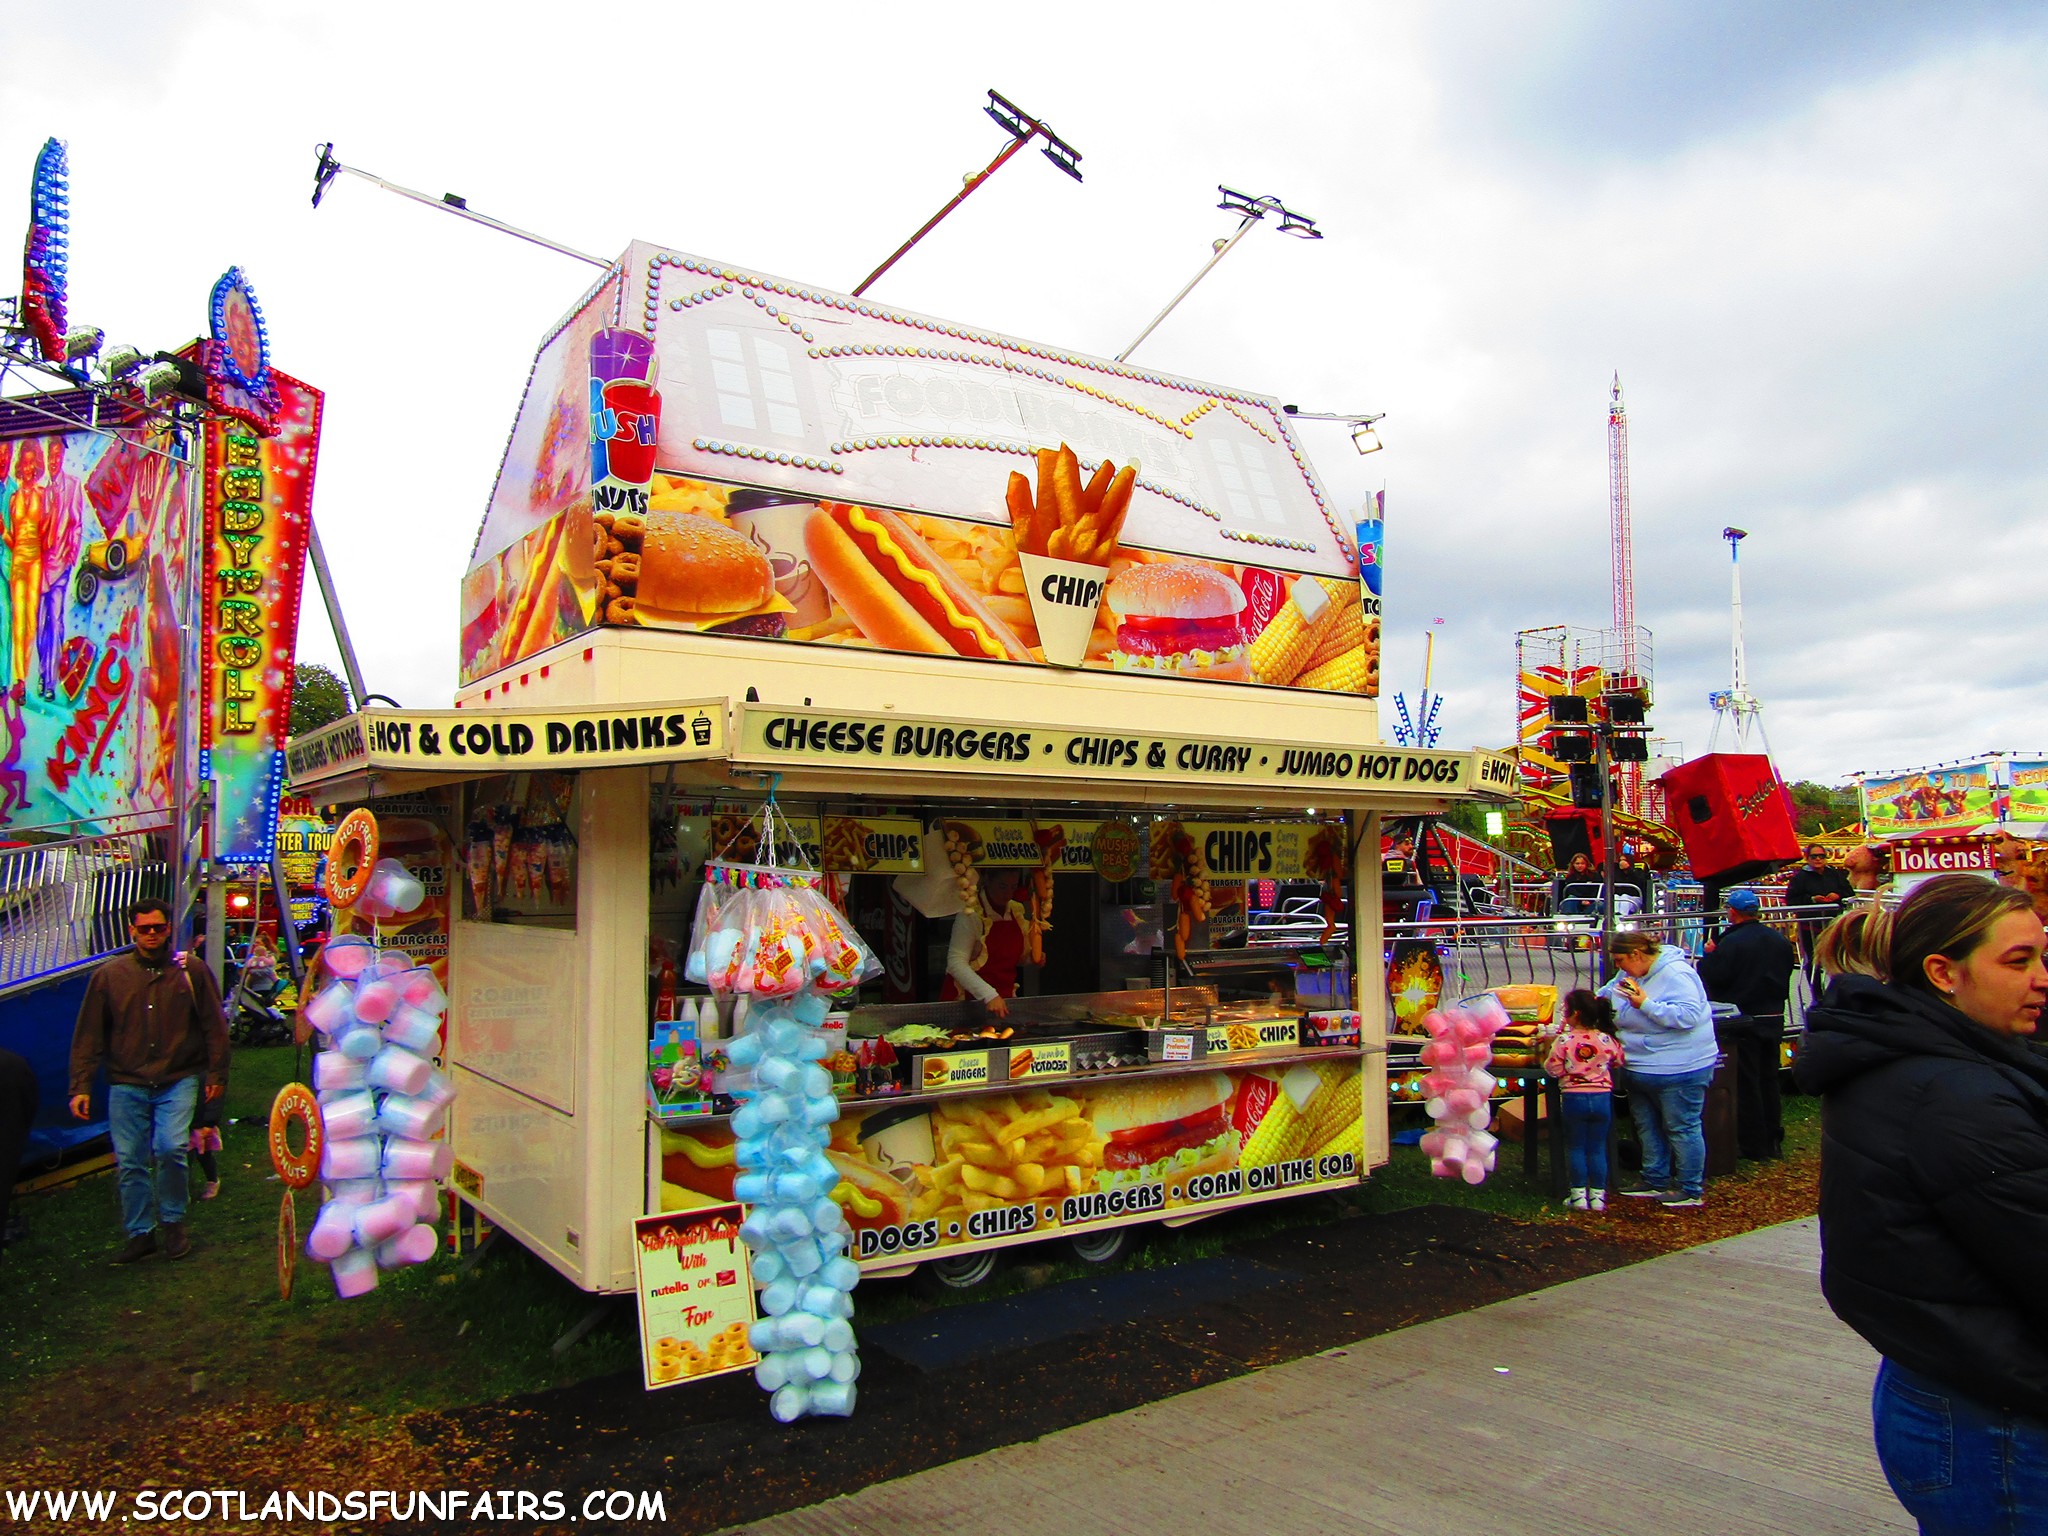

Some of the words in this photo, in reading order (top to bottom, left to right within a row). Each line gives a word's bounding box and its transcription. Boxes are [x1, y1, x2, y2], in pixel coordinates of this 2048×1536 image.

[590, 408, 656, 446] USH
[592, 485, 649, 516] NUTS
[219, 600, 263, 736] ROLL
[376, 720, 411, 754] HOT
[419, 723, 441, 755] &
[450, 723, 533, 755] COLD
[545, 713, 686, 755] DRINKS
[764, 717, 886, 755] CHEESE
[893, 725, 1031, 762] BURGERS
[1066, 736, 1139, 767] CHIPS
[1147, 742, 1166, 769] &
[1177, 744, 1252, 772] CURRY
[1276, 749, 1352, 779] JUMBO
[1357, 754, 1405, 779] HOT
[1404, 757, 1460, 783] DOGS
[1489, 758, 1511, 785] HOT
[340, 820, 359, 846] HOT
[358, 820, 373, 868] FRESH
[864, 833, 921, 861] CHIPS
[986, 841, 1040, 861] BURGERS
[1096, 838, 1136, 852] MUSHY
[1204, 830, 1273, 874] CHIPS
[1895, 847, 1981, 870] Tokens
[1981, 843, 1992, 869] HERE
[1102, 852, 1129, 867] PEAS
[329, 860, 357, 900] DONUTS
[390, 933, 447, 947] BURGERS
[1259, 1024, 1296, 1042] CHIPS
[950, 1067, 987, 1082] BURGERS
[279, 1095, 299, 1117] HOT
[299, 1098, 319, 1153] FRESH
[274, 1132, 308, 1180] DONUTS
[859, 1219, 938, 1256] DOGS
[967, 1204, 1036, 1237] CHIPS
[1062, 1182, 1164, 1222] BURGERS
[1186, 1171, 1242, 1200] CORN
[1246, 1167, 1277, 1189] ON
[1280, 1161, 1314, 1185] THE
[1317, 1153, 1355, 1178] COB
[666, 1231, 698, 1249] Fresh
[680, 1252, 708, 1270] With
[650, 1281, 689, 1298] nutella
[697, 1276, 713, 1291] or
[681, 1305, 715, 1328] For
